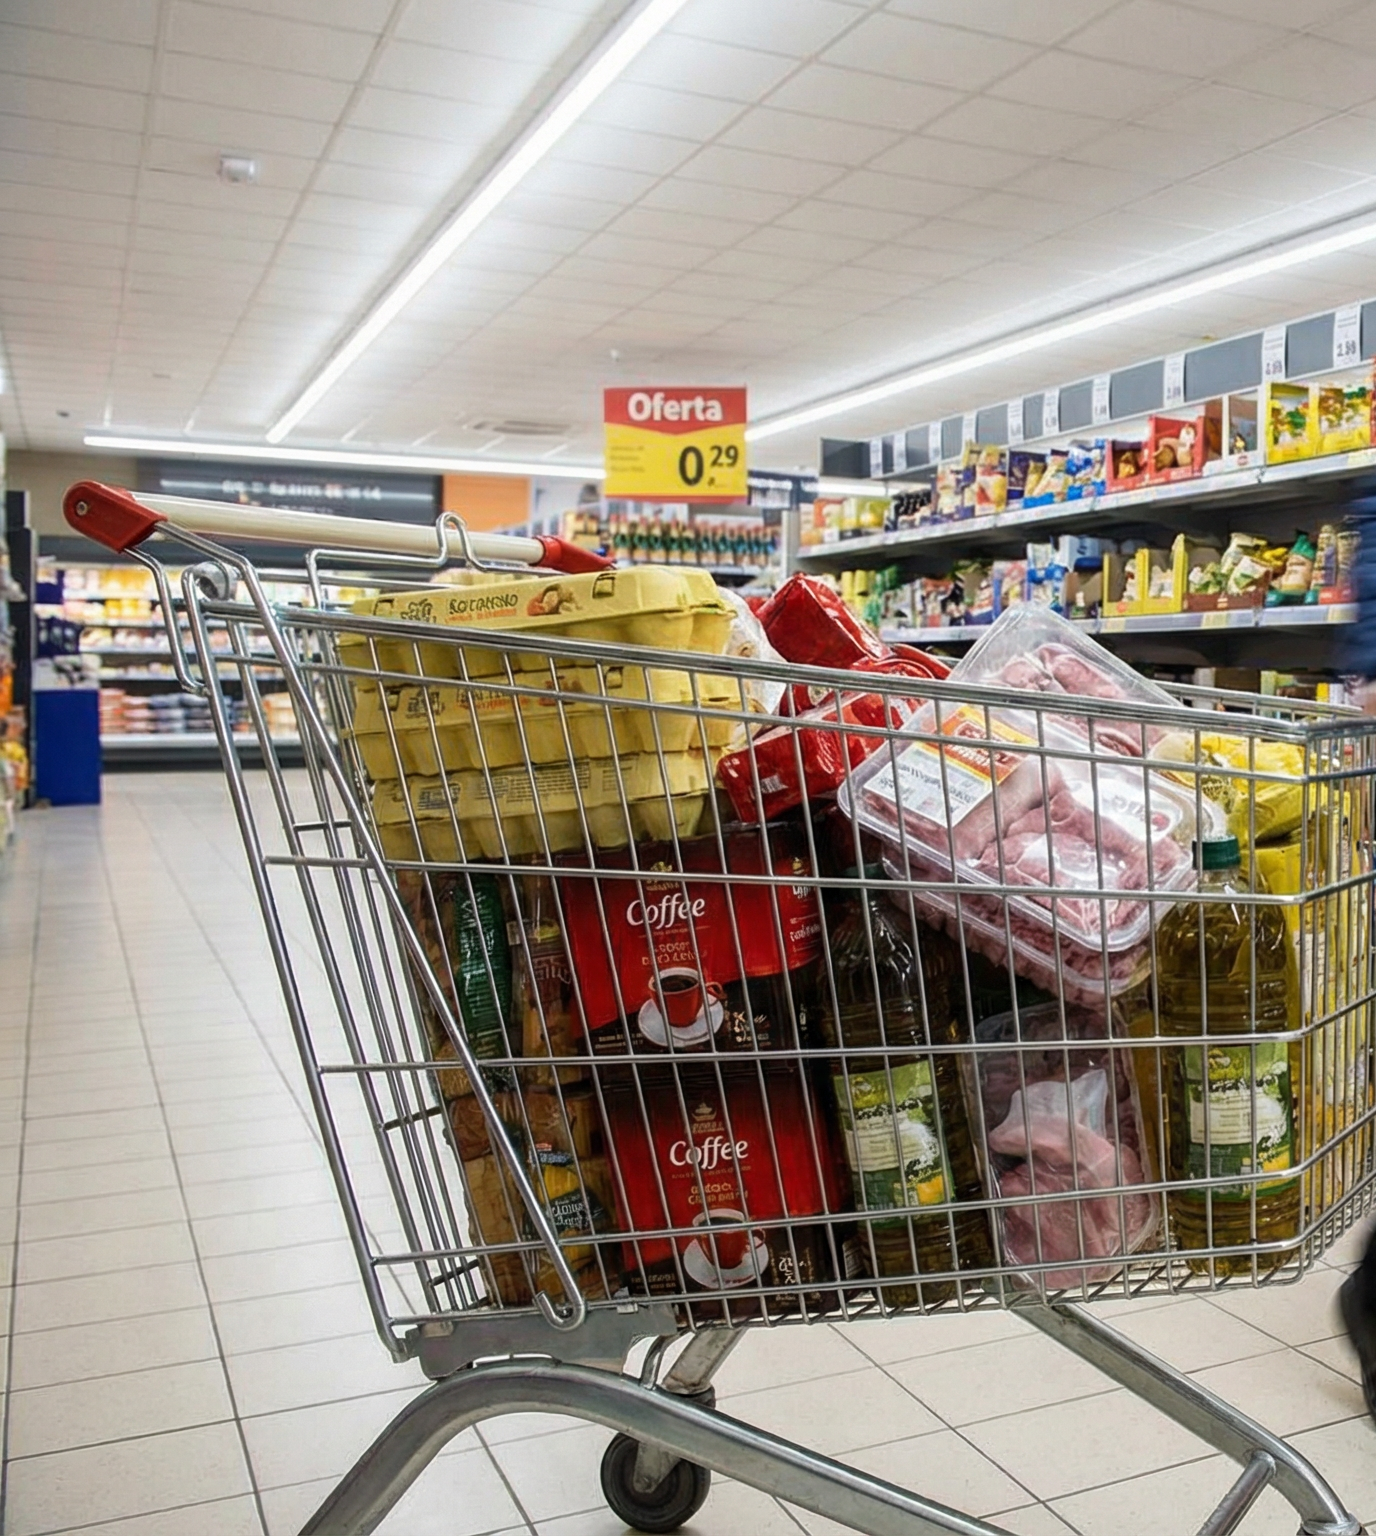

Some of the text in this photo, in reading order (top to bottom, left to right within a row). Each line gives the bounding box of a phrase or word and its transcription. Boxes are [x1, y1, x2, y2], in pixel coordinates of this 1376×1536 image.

[627, 391, 723, 422] Oferta
[626, 893, 706, 930] Coffee
[669, 1135, 749, 1170] Coffee
